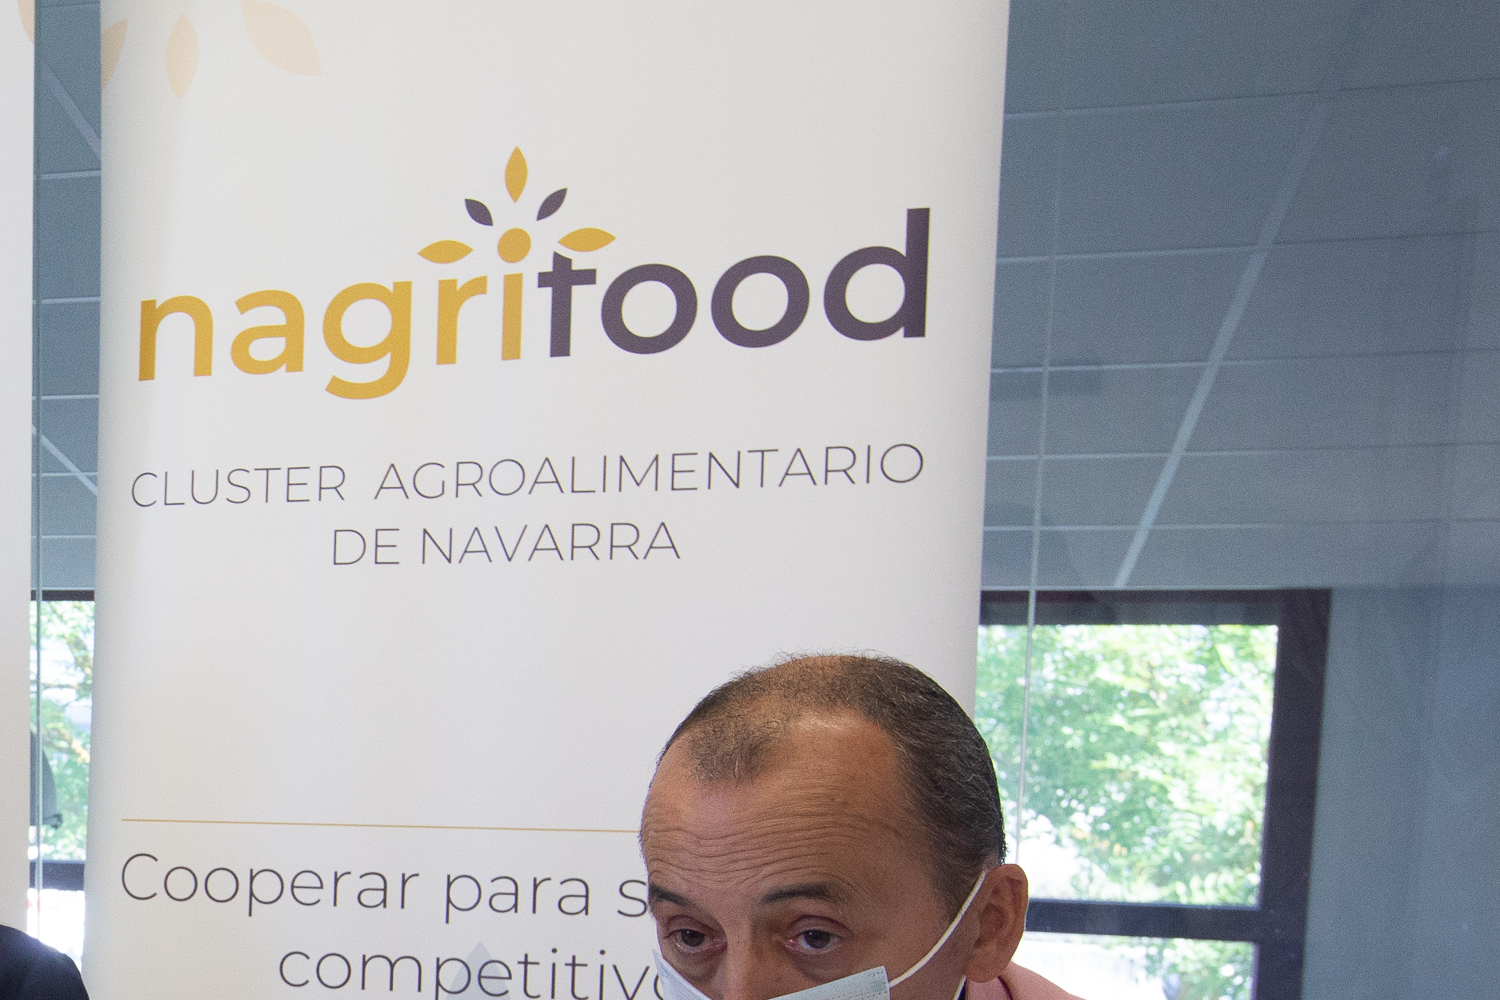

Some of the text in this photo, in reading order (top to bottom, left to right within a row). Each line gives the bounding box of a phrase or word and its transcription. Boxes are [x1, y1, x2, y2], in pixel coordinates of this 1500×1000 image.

[137, 207, 932, 401] nagrifood
[130, 442, 925, 508] CLUSTER AGROALIMENTARIO
[331, 521, 682, 567] DE NAVARRA
[120, 852, 419, 917] Cooperar
[445, 873, 592, 924] para
